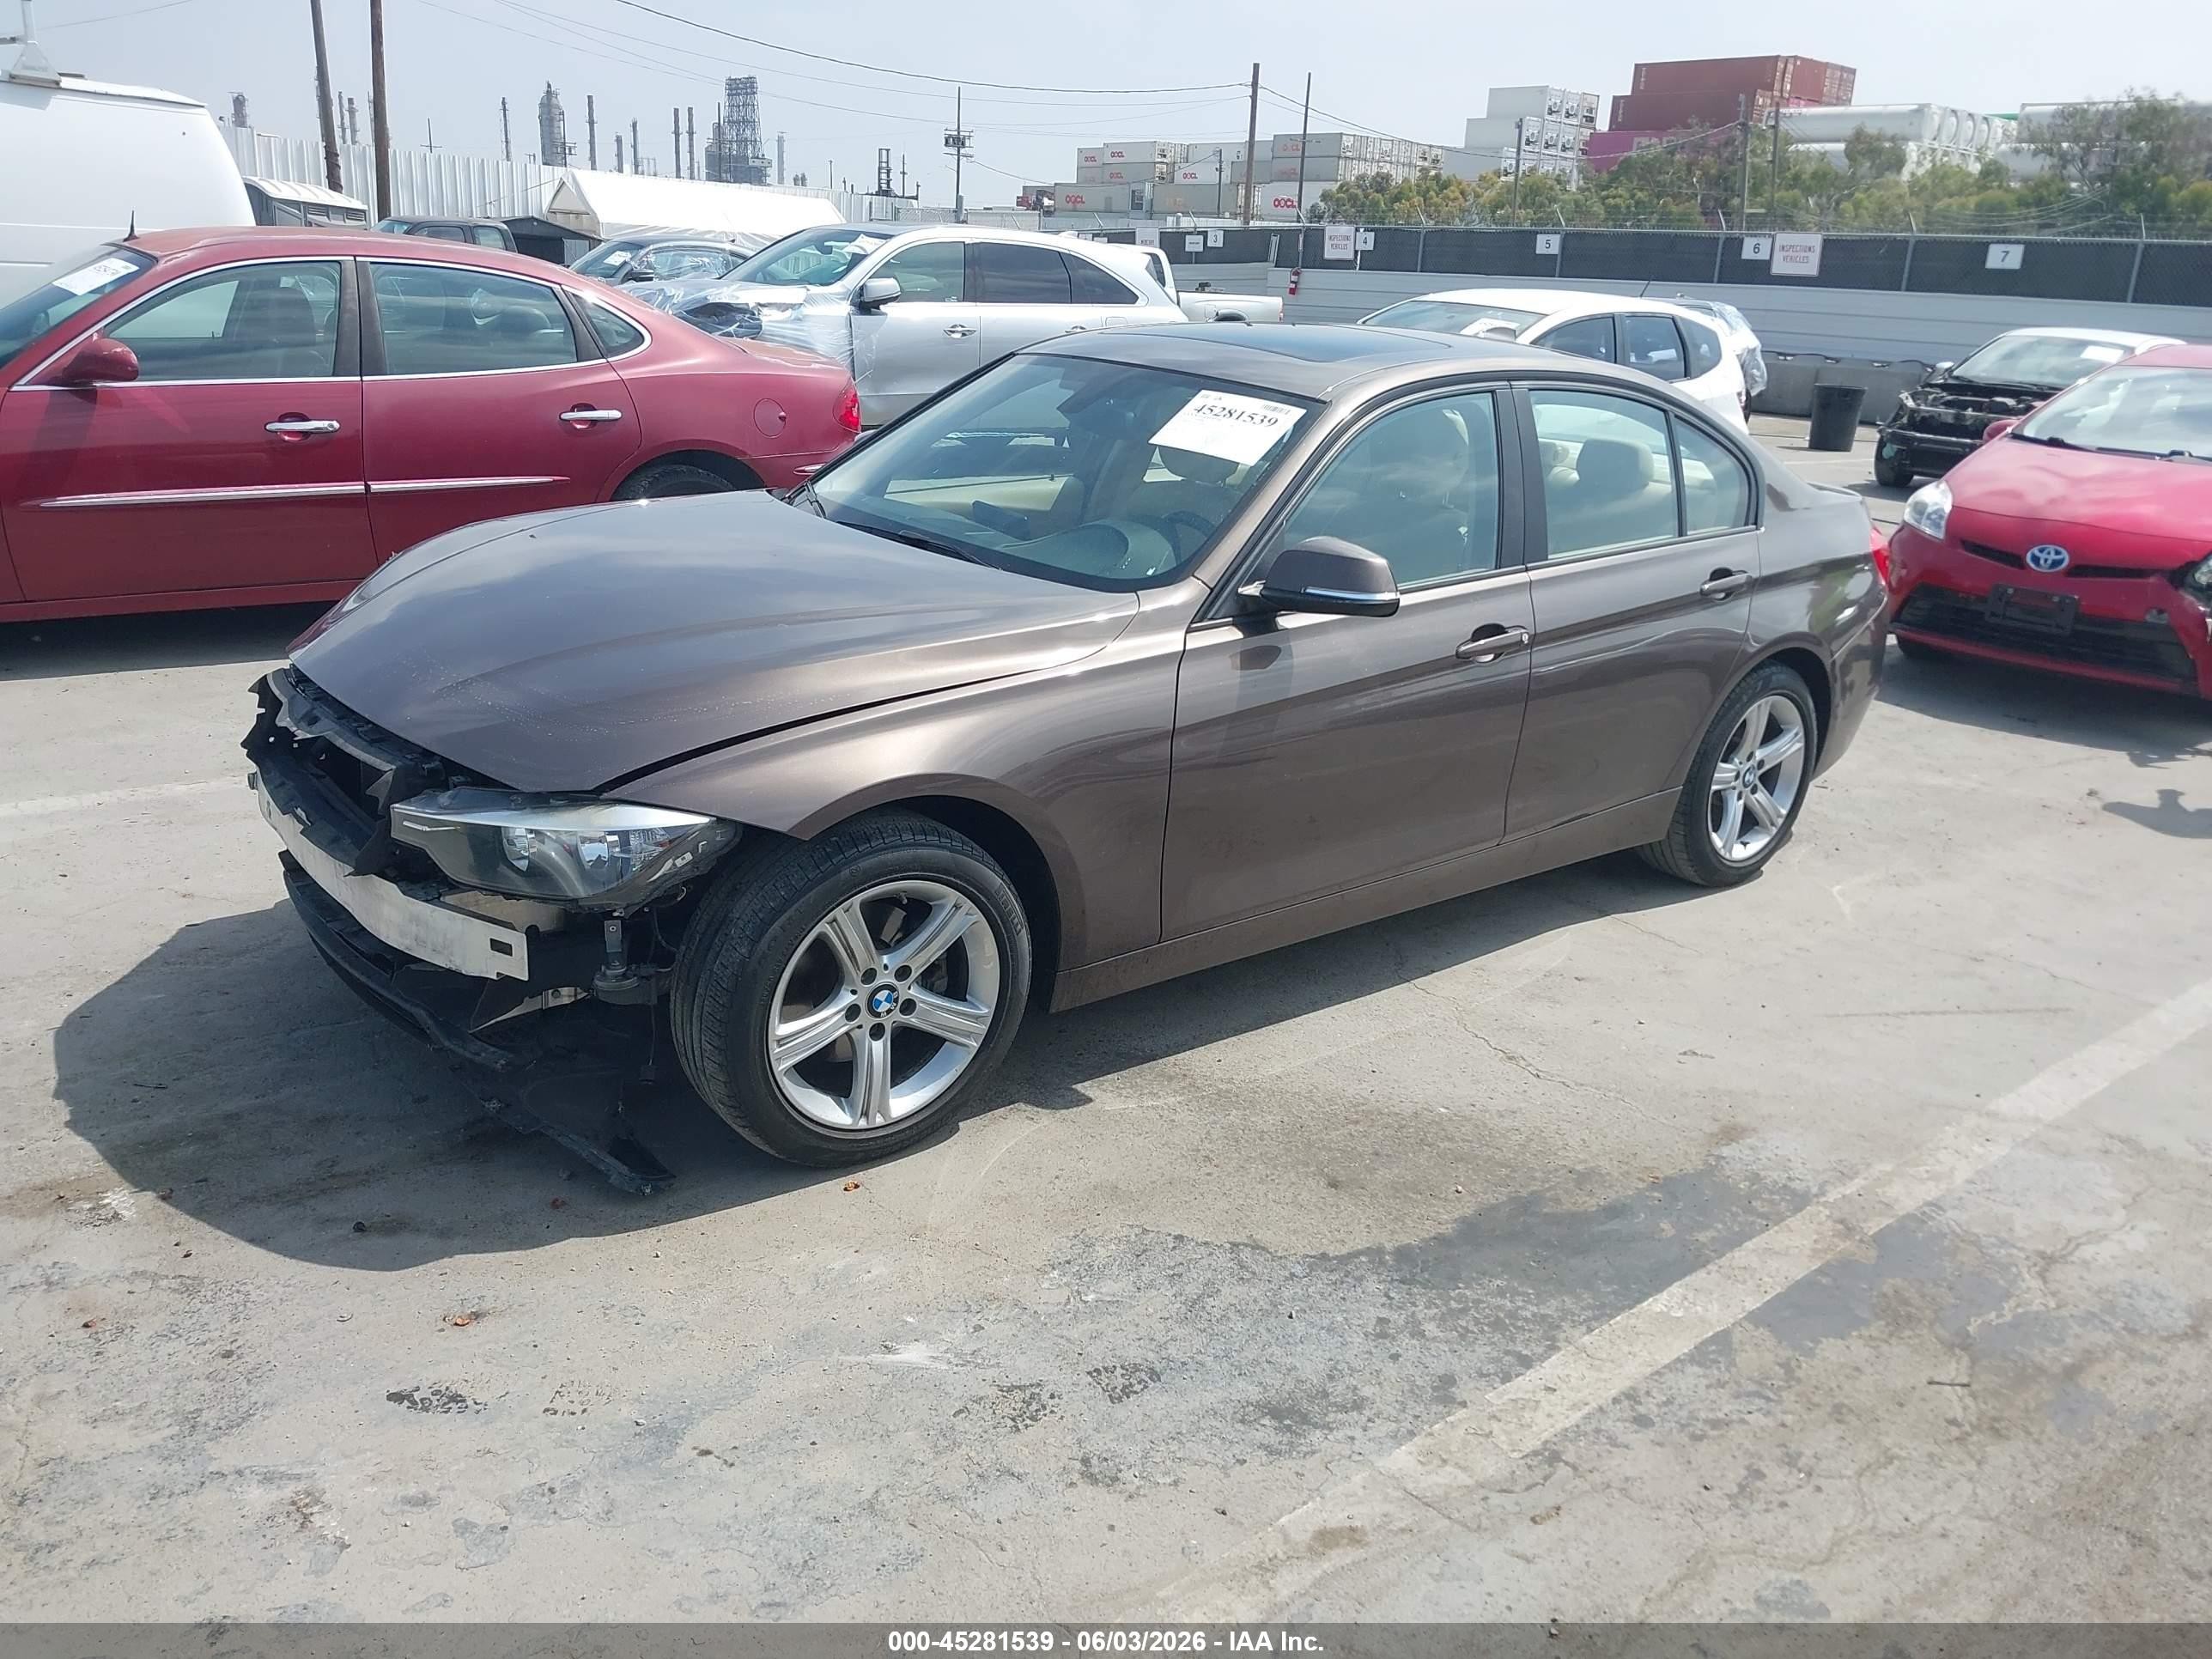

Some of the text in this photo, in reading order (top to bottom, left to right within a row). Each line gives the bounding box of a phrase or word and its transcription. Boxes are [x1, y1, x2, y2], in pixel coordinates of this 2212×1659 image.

[1066, 195, 1085, 204] OOCL
[1273, 198, 1297, 208] OOCL
[1362, 236, 1368, 246] 4
[1545, 239, 1552, 249] 5
[1753, 243, 1760, 254] 6
[1779, 245, 1815, 253] INSPECTIONS
[2001, 251, 2009, 263] 7
[1193, 404, 1279, 428] 45281539
